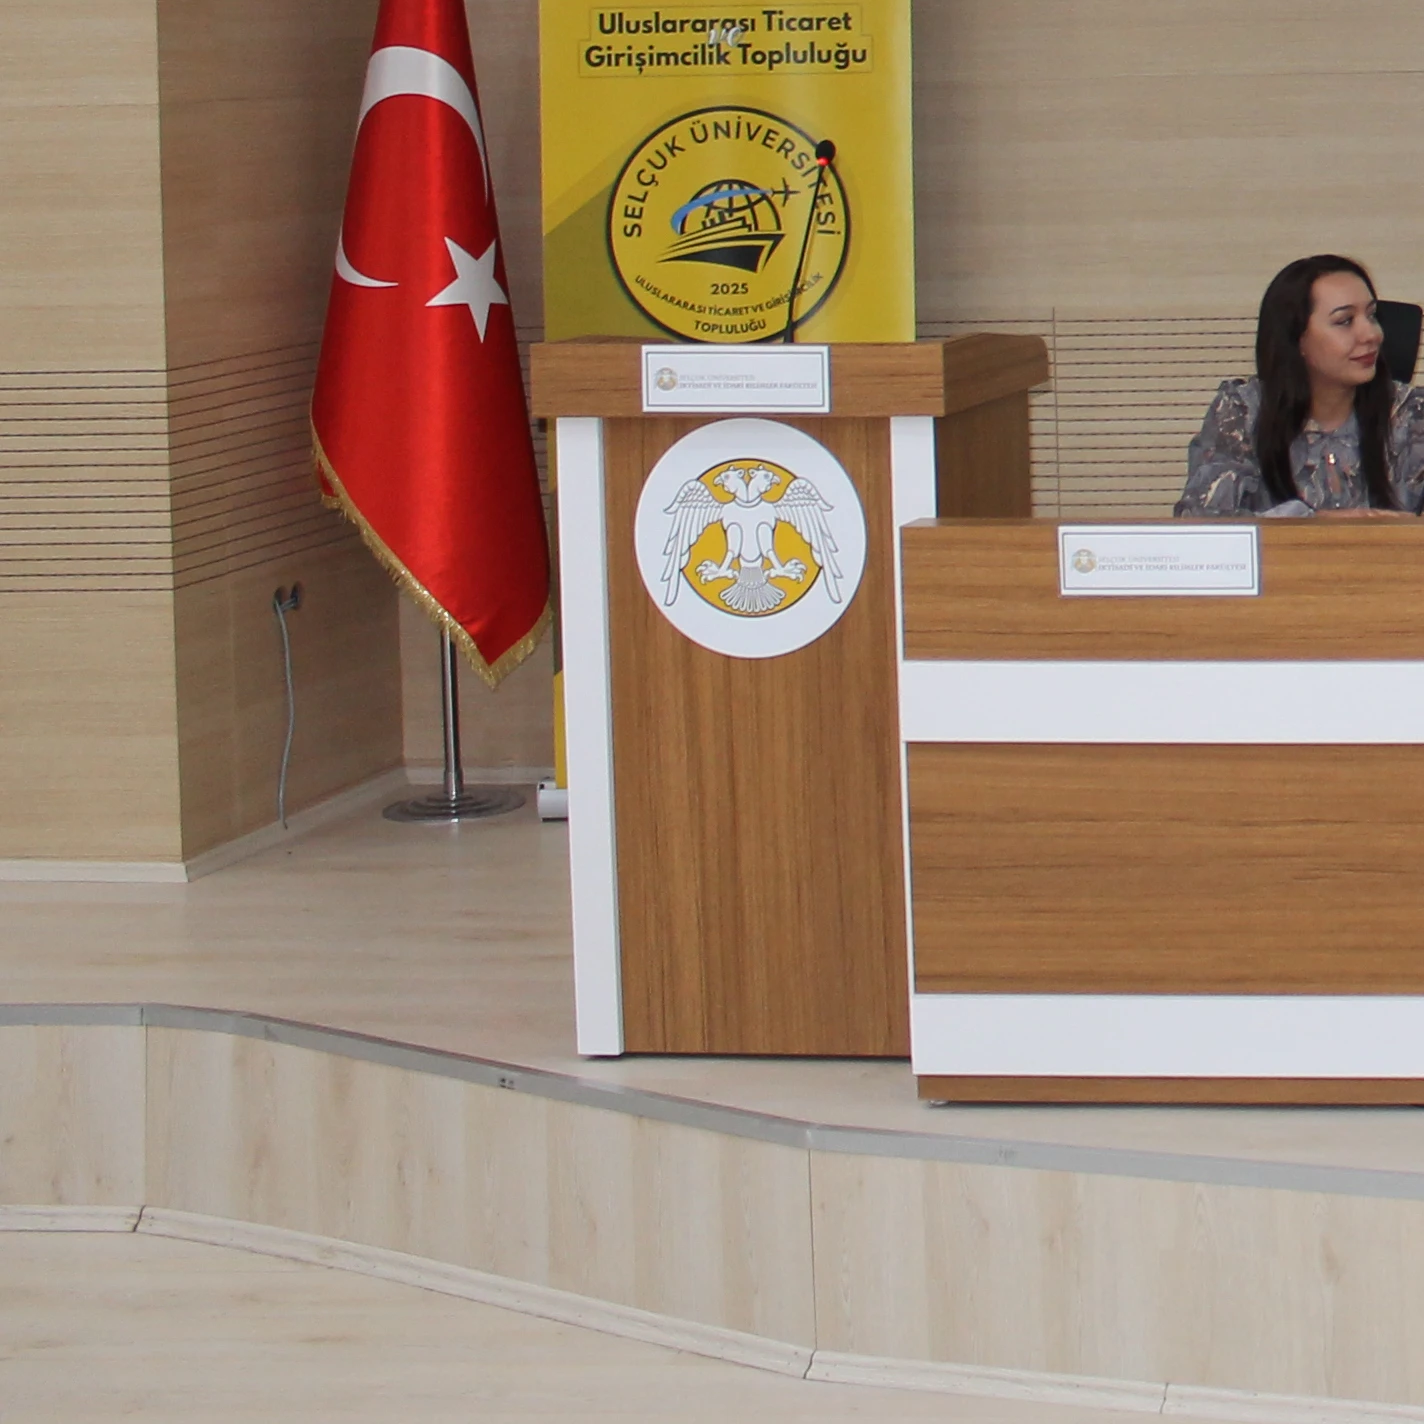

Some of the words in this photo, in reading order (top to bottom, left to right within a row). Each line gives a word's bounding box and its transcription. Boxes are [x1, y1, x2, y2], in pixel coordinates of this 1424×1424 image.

[599, 12, 756, 35] Uluslararası
[761, 10, 852, 32] Ticaret
[585, 43, 731, 75] Girişimcilik
[737, 41, 867, 70] Topluluğu
[623, 135, 686, 238] SELÇUK
[634, 275, 707, 314] ULUSLARARASI
[708, 303, 750, 316] TİCARET
[750, 304, 764, 314] VE
[710, 282, 749, 295] 2025
[694, 318, 767, 334] TOPLULUĞU
